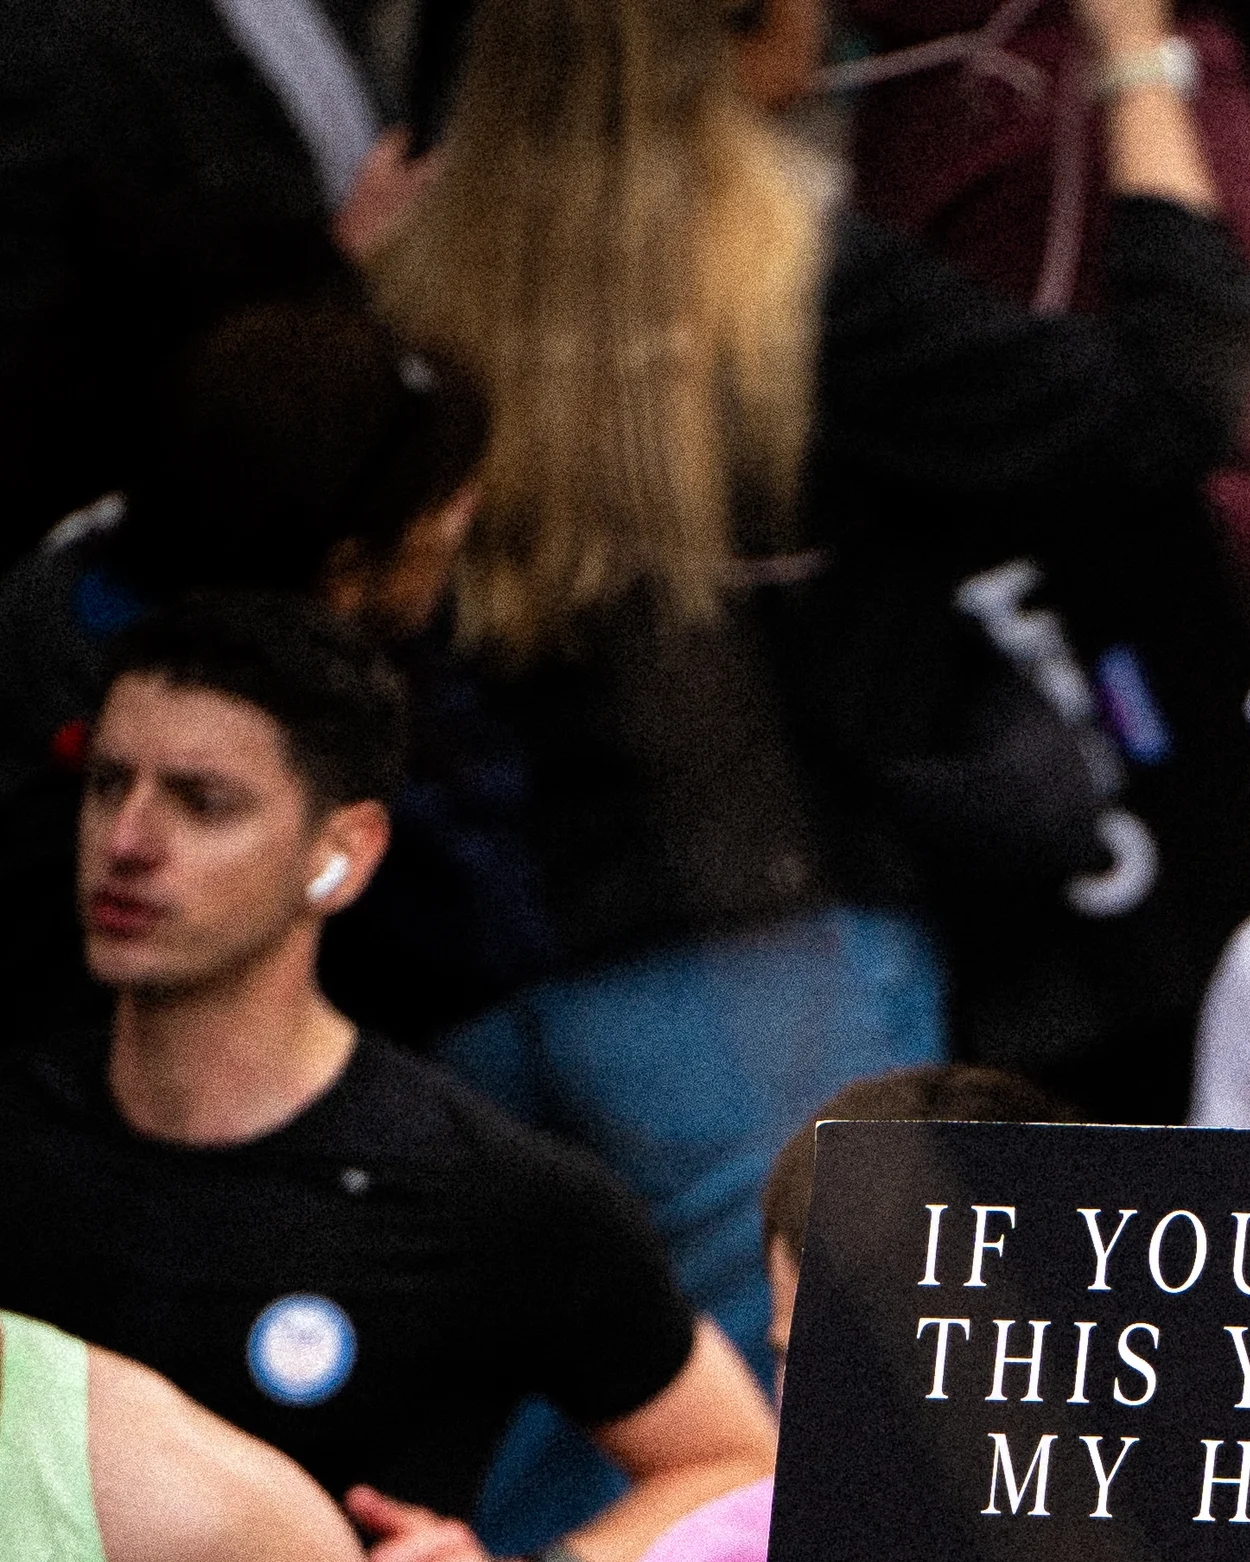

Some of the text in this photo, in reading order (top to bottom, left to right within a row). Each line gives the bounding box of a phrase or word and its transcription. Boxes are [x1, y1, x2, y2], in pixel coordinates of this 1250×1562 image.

[917, 1203, 1016, 1287] IF
[916, 1317, 1160, 1407] THIS
[980, 1432, 1140, 1519] MY
